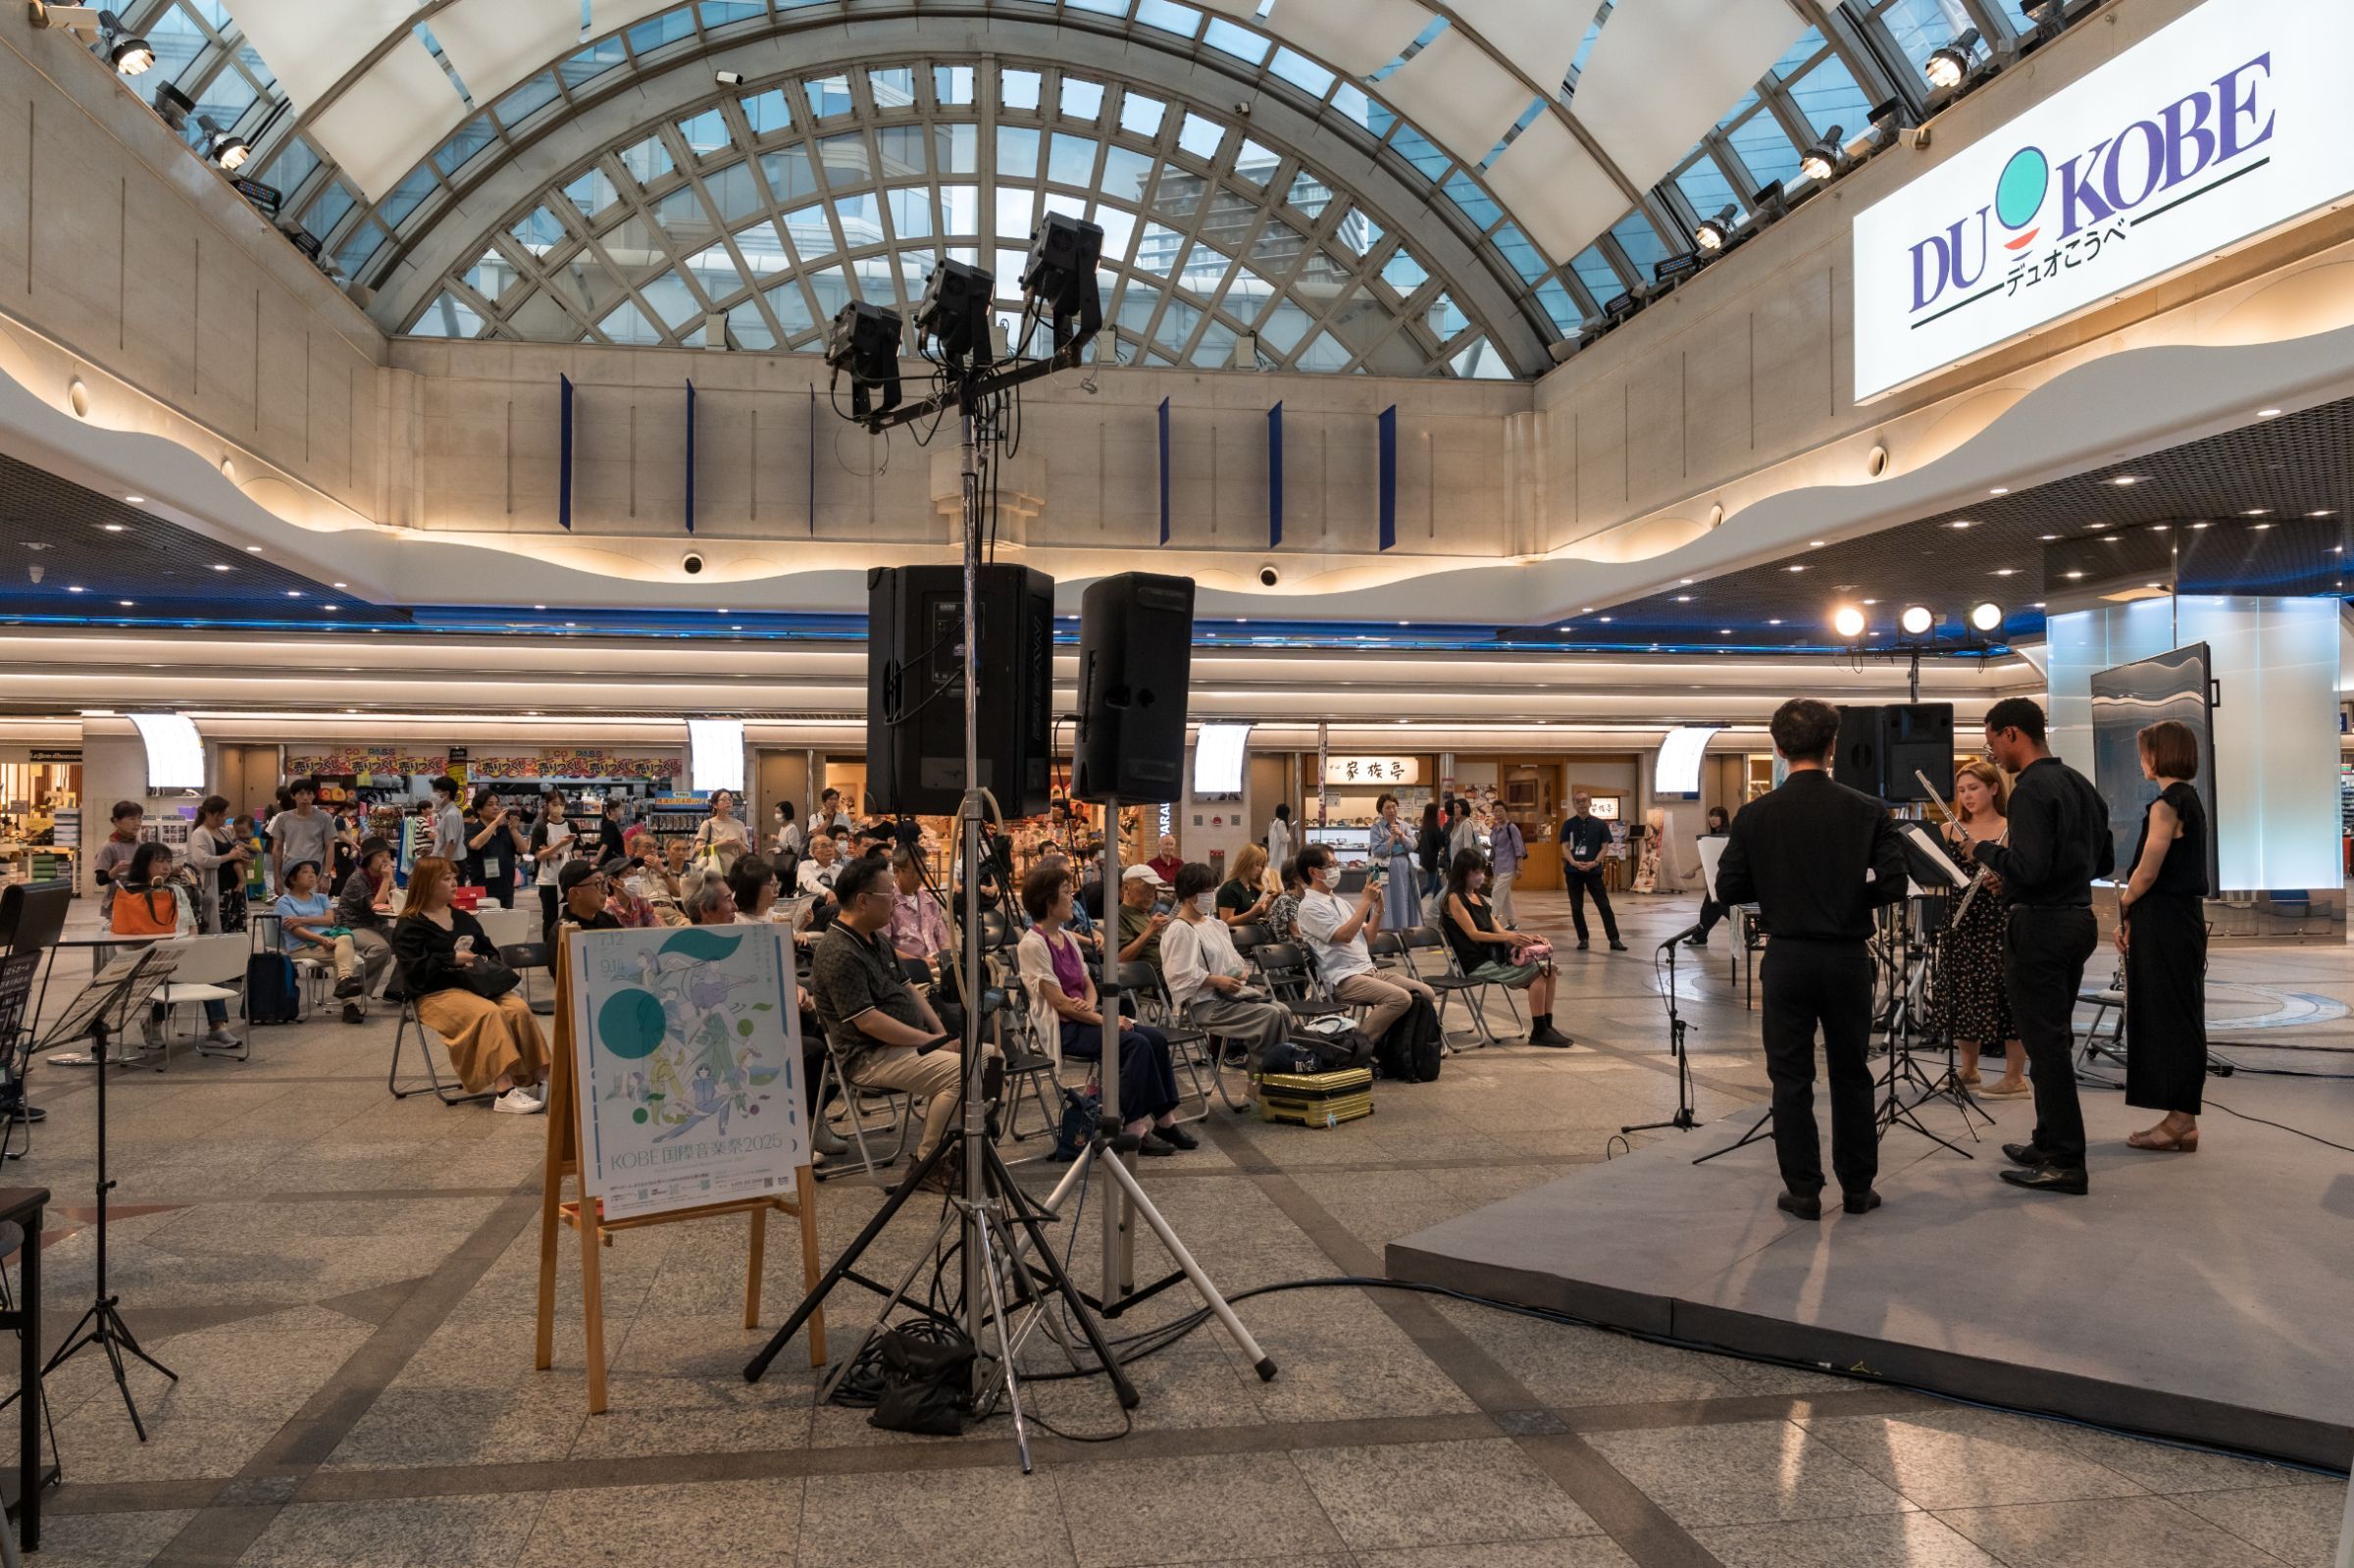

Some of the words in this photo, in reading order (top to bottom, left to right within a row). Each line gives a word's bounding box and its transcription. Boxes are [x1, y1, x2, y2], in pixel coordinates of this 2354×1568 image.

[2055, 50, 2277, 241] KOBE
[2003, 217, 2126, 297] デュオこうべ
